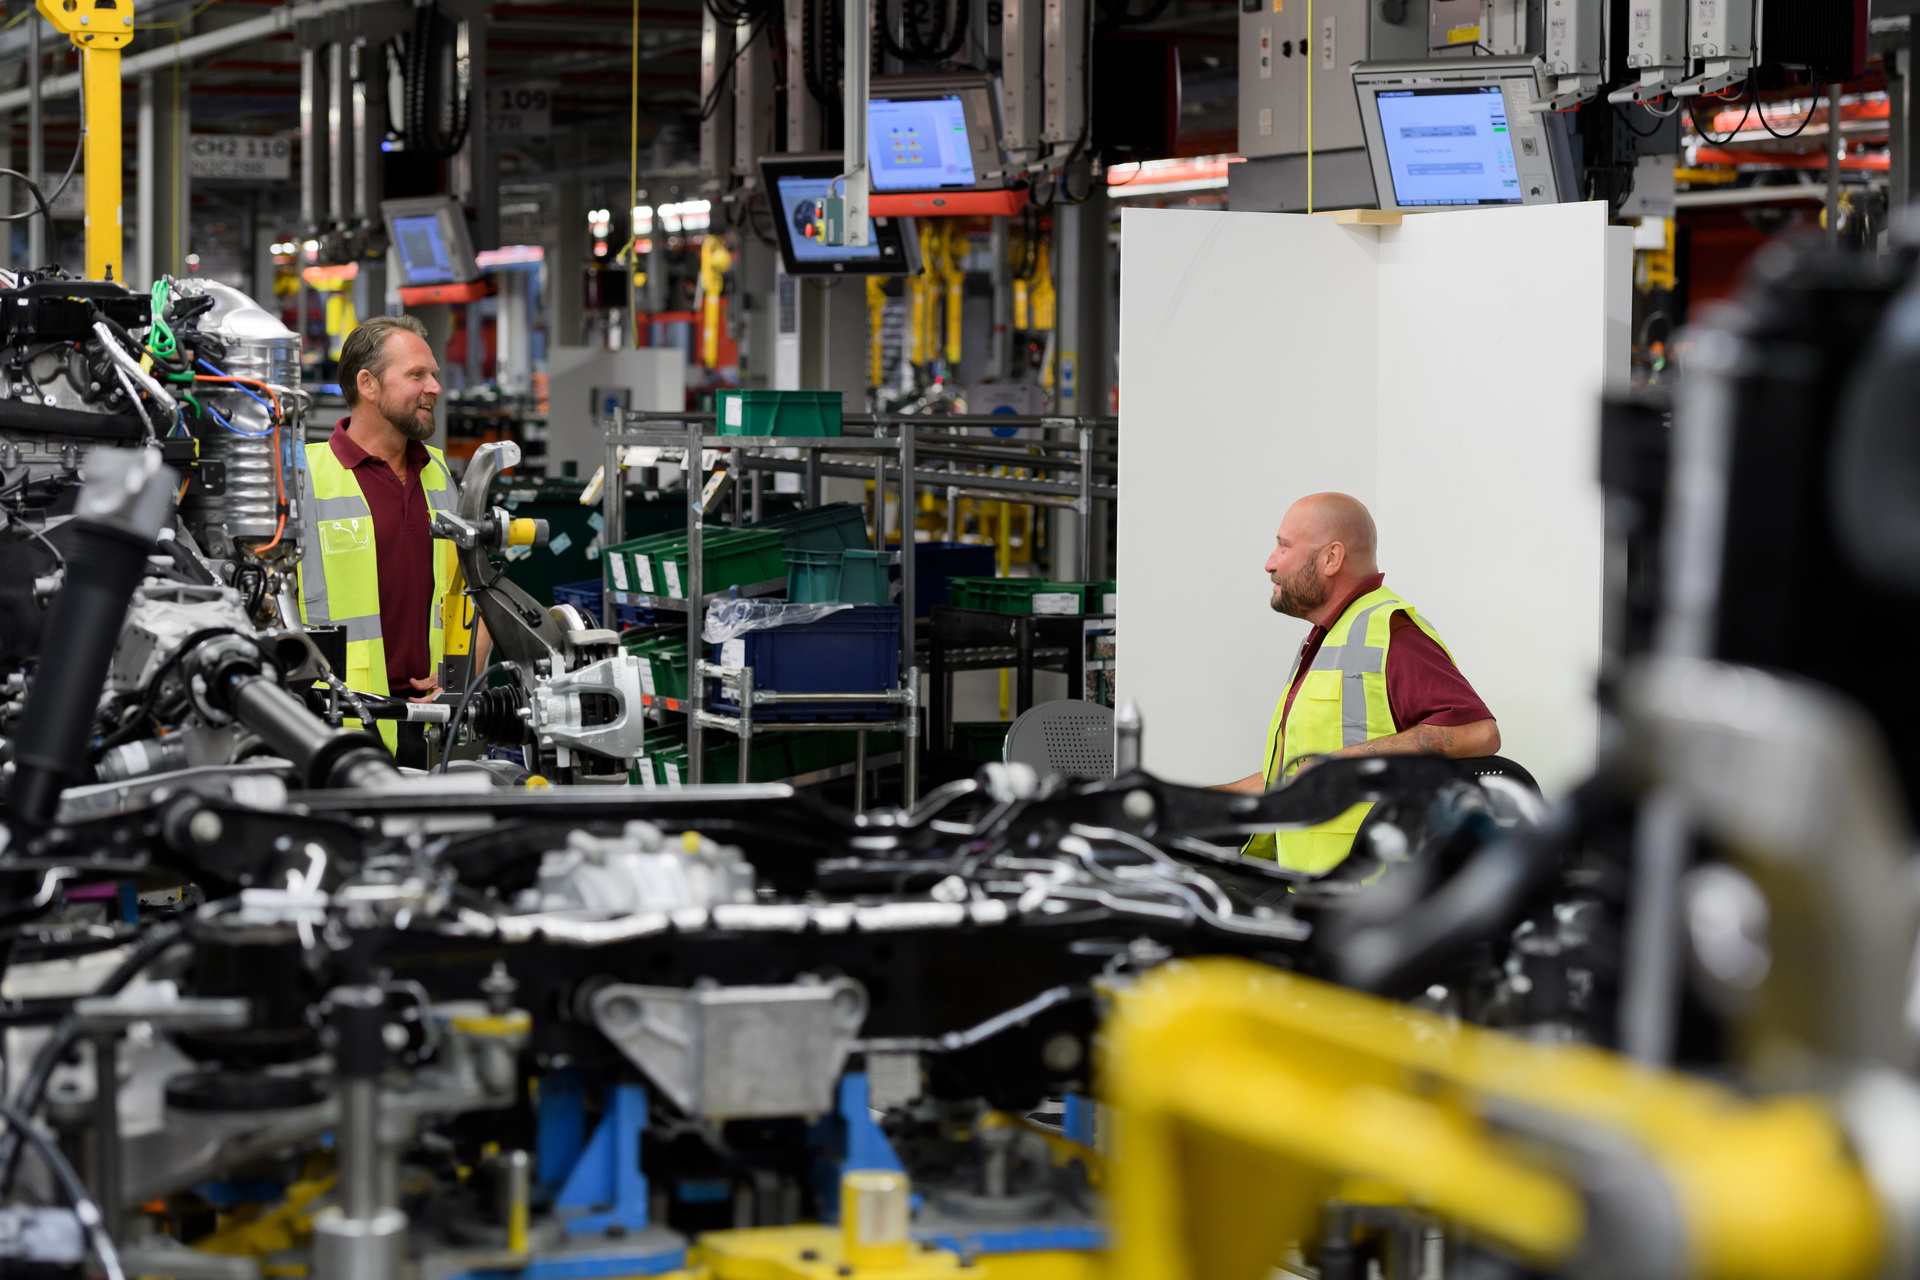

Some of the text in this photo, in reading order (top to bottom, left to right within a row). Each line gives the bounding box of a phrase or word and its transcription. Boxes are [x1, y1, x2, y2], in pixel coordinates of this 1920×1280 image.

[500, 89, 549, 111] 109
[193, 138, 290, 158] CH2 110
